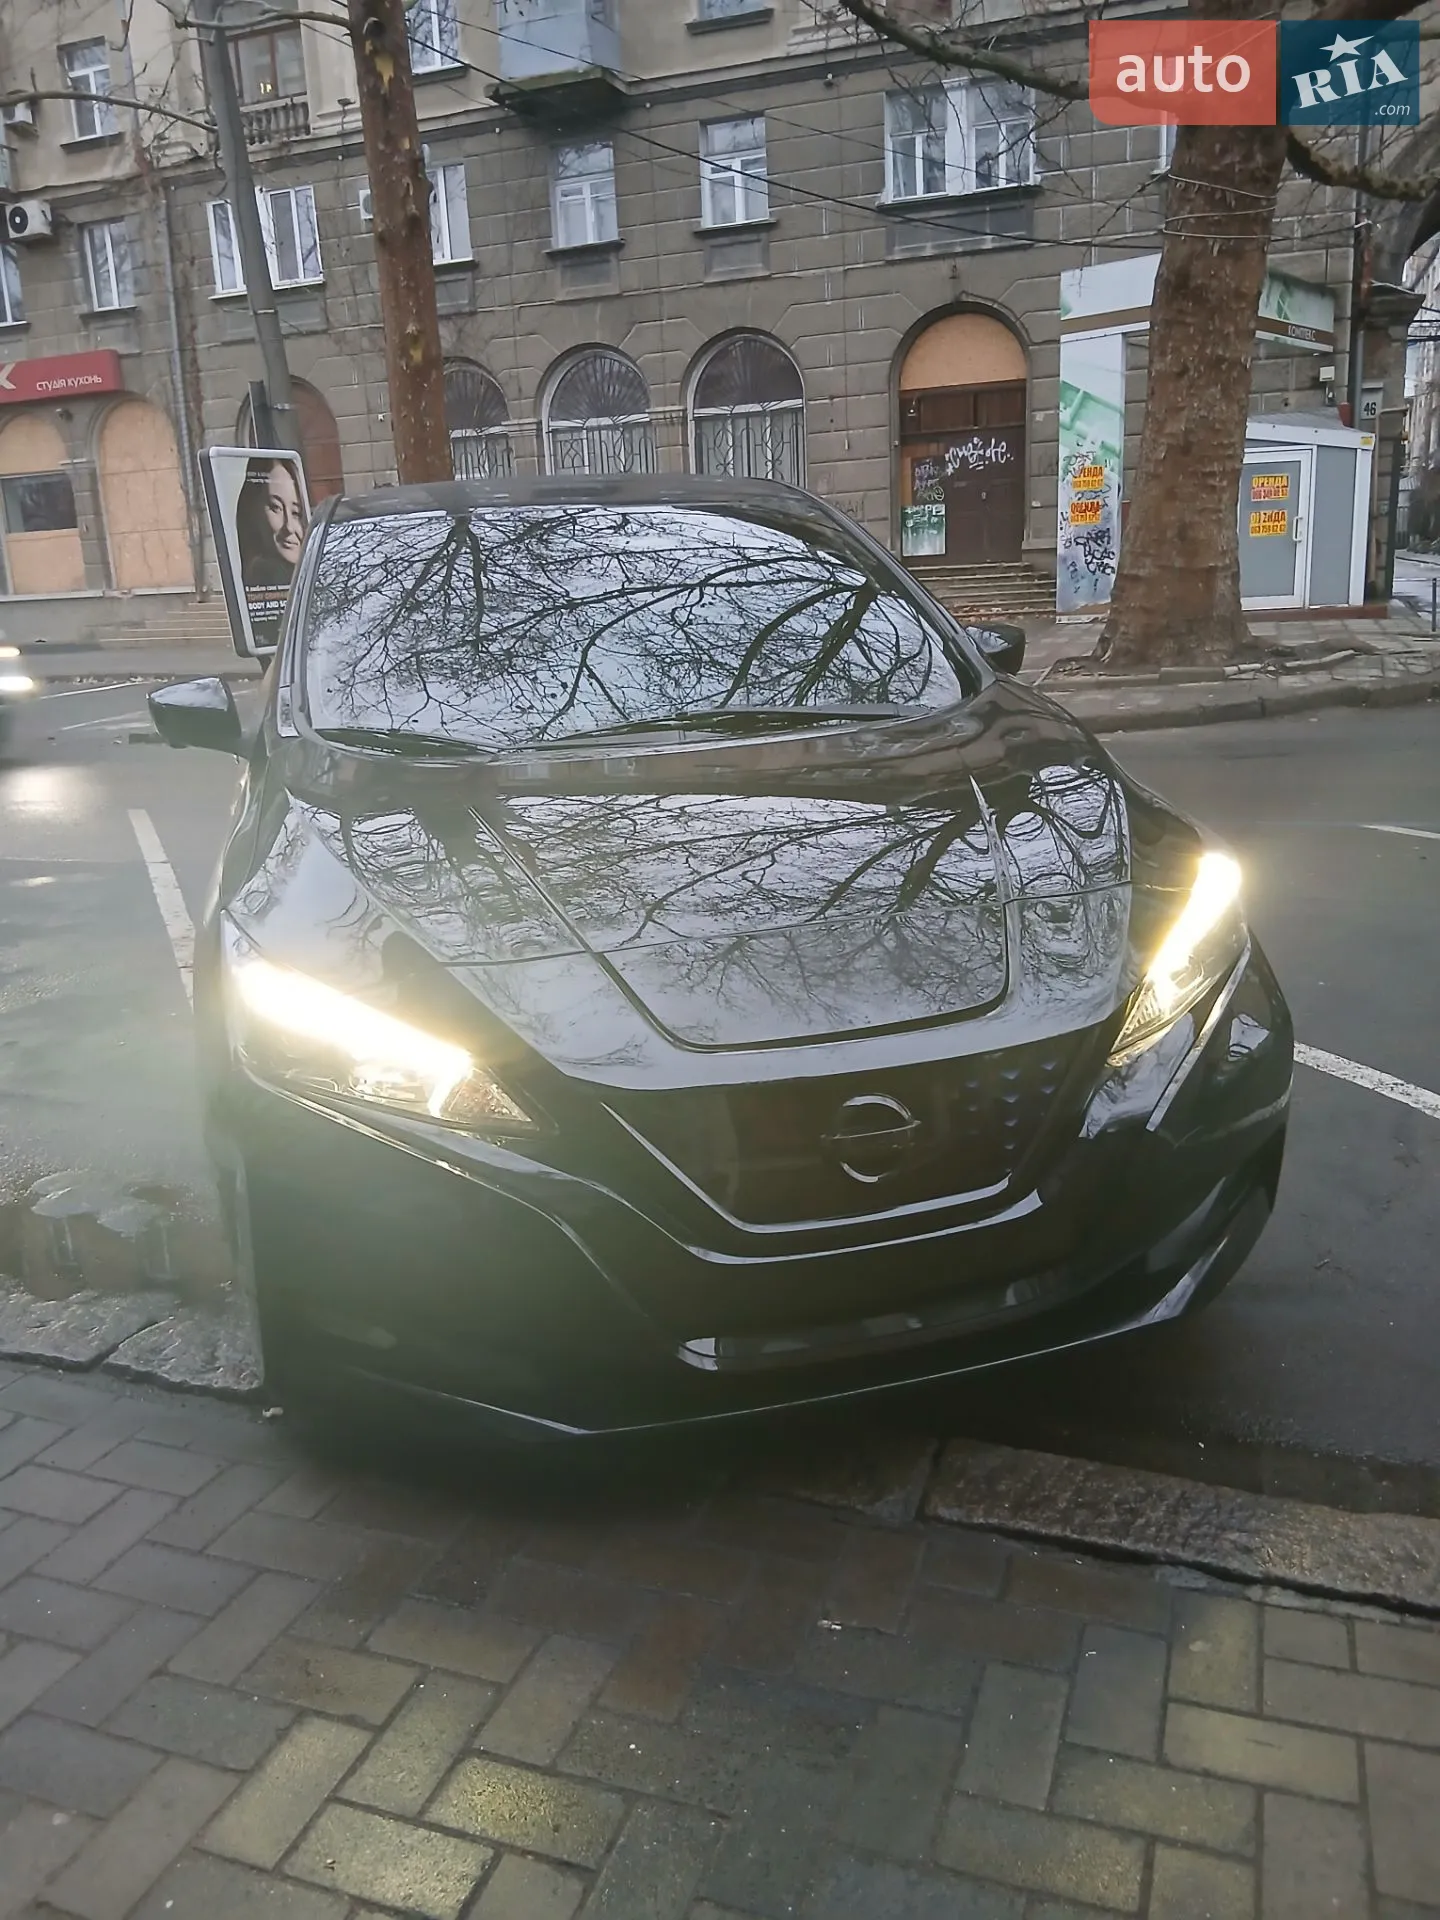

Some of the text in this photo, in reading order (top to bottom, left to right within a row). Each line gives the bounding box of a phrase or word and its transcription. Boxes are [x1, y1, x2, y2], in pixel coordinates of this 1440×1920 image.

[67, 374, 101, 388] КУХОНЬ
[1363, 402, 1377, 416] 46
[1074, 466, 1102, 477] РЕНДА
[1252, 476, 1289, 488] ОРЕНДА
[266, 601, 279, 609] AND
